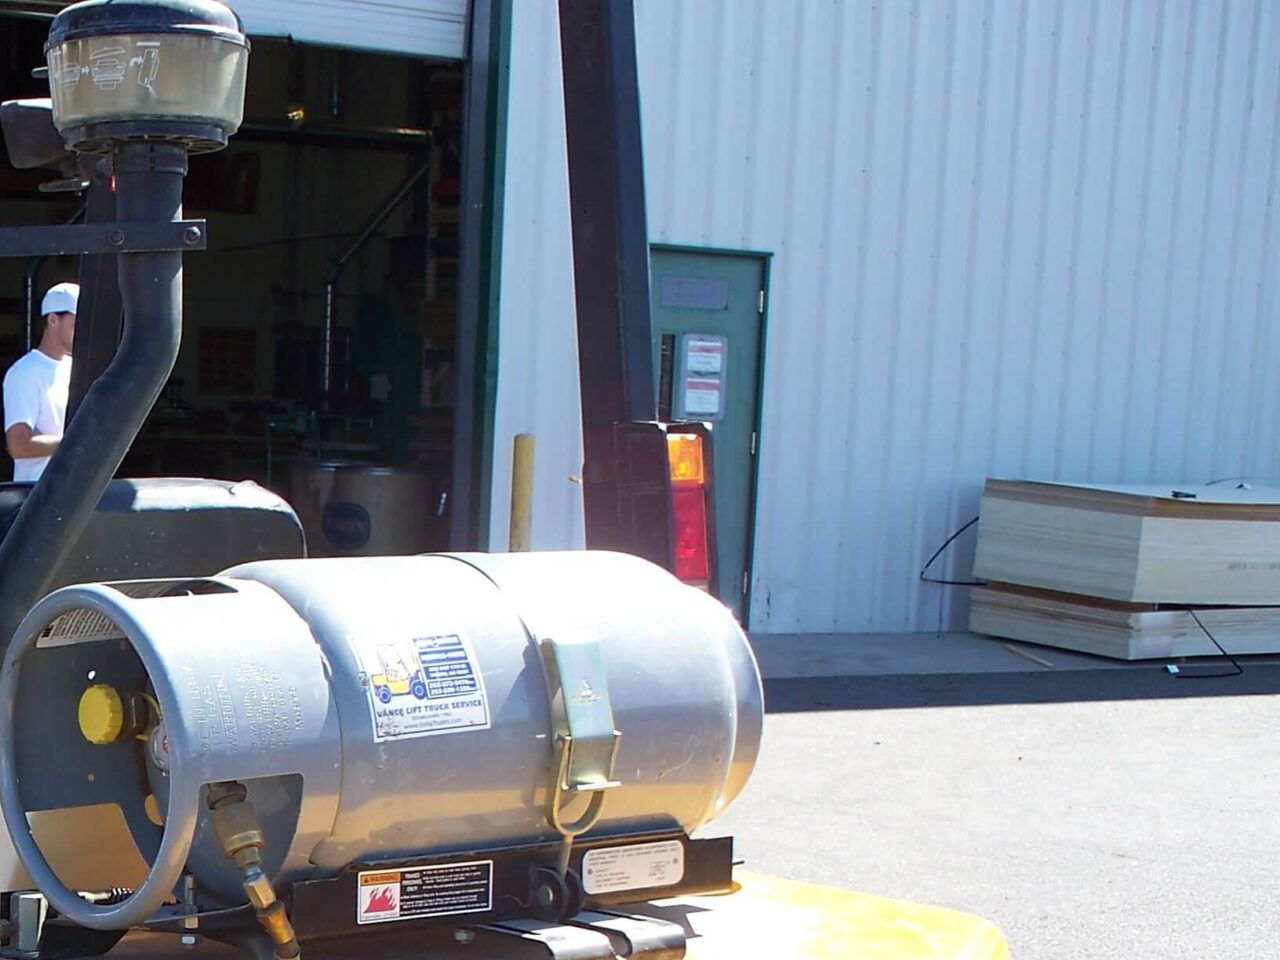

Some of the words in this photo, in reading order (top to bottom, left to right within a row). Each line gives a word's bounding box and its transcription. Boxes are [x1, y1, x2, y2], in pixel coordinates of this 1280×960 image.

[376, 708, 404, 717] VANCE
[406, 706, 422, 714] LIFT
[424, 703, 449, 712] TRUCK
[451, 700, 482, 709] SERVICE
